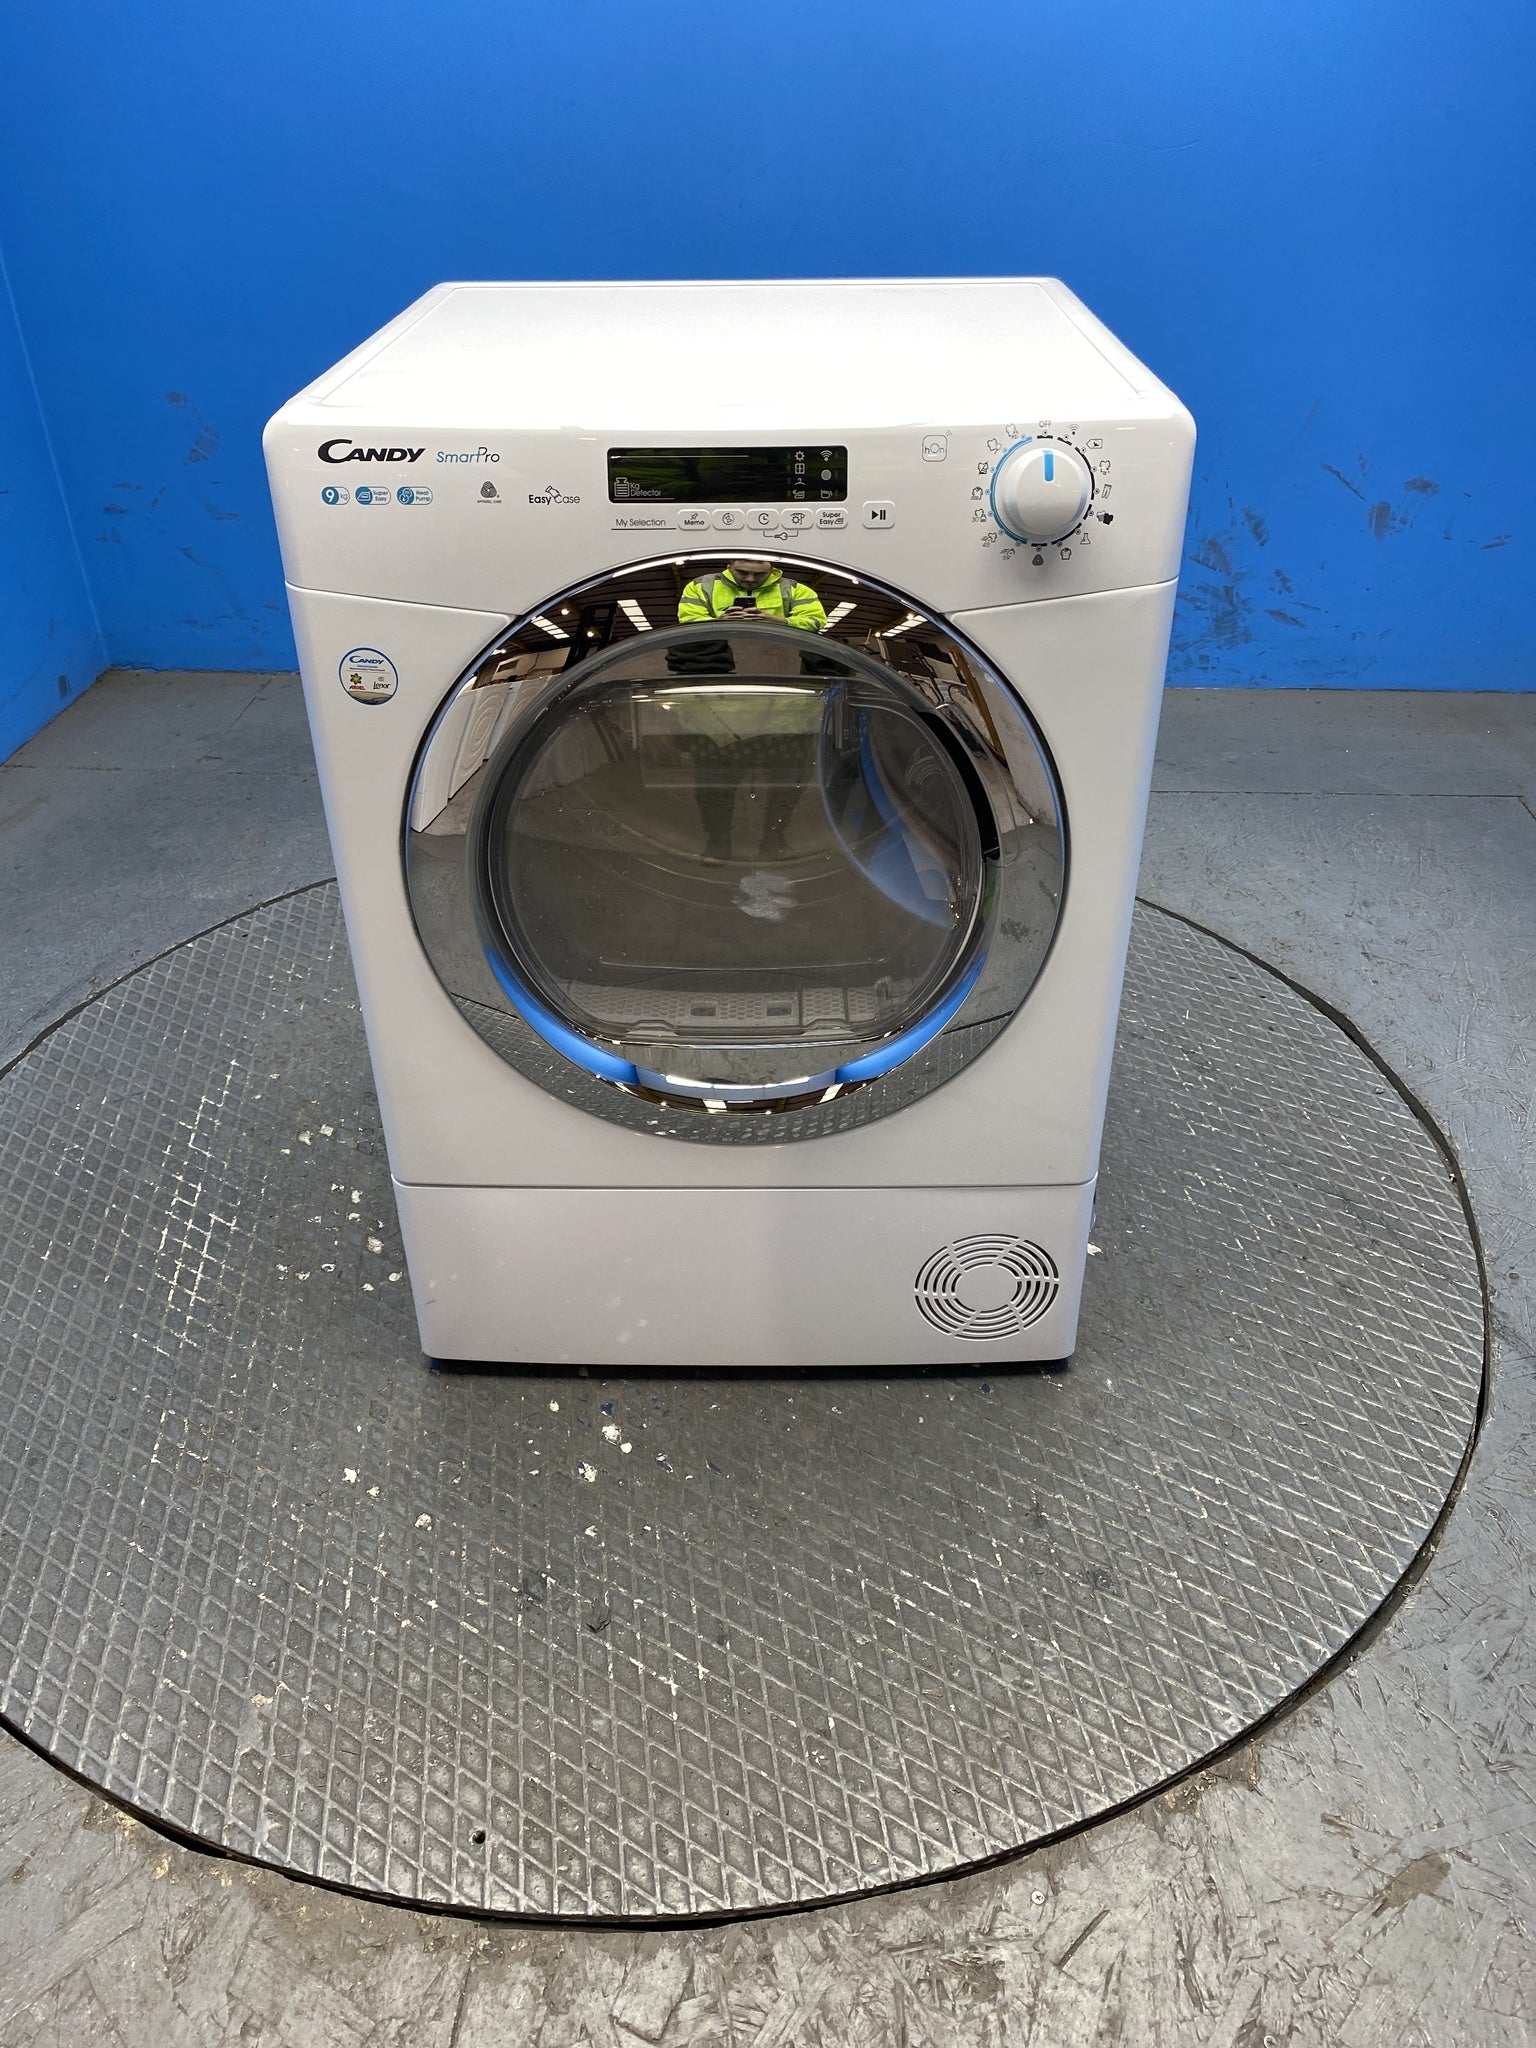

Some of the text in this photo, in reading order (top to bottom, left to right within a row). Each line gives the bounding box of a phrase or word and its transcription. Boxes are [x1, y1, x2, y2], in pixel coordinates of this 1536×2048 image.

[1038, 420, 1052, 428] OFF
[325, 489, 335, 503] 9
[630, 488, 661, 497] Detector
[822, 511, 841, 519] Super
[615, 518, 666, 528] My Selection
[819, 518, 834, 526] Easy
[373, 681, 391, 690] Lenor
